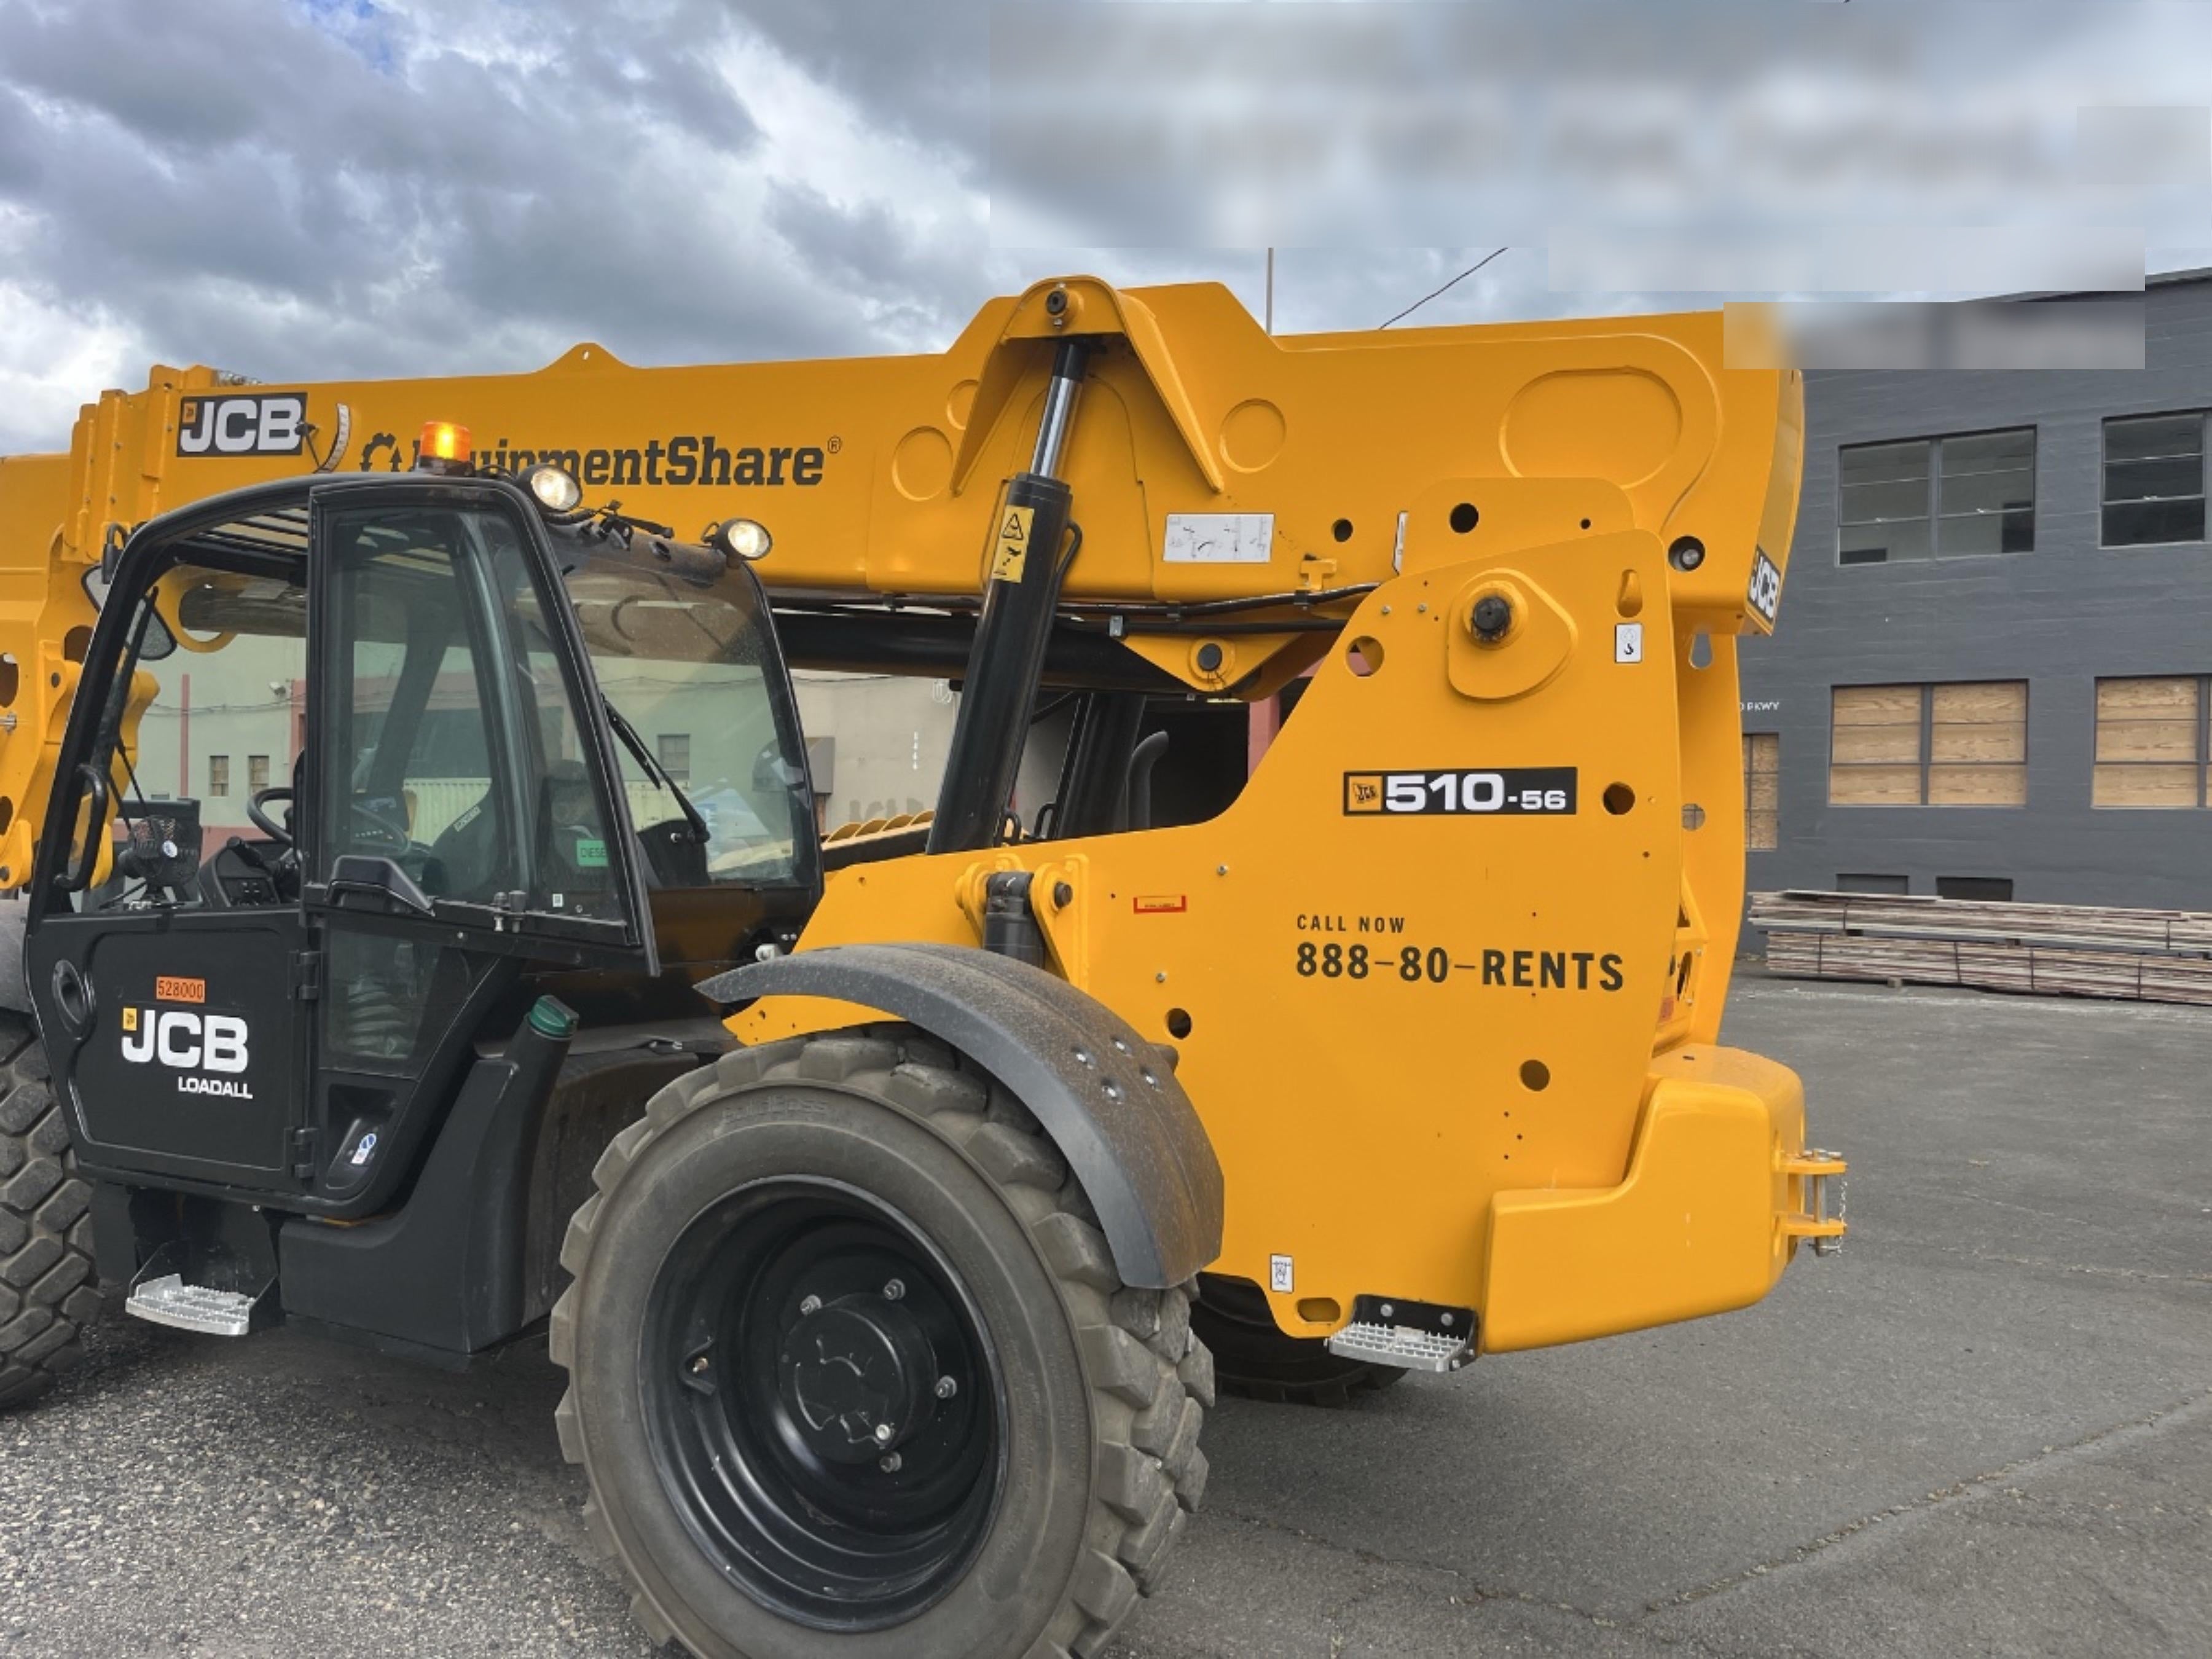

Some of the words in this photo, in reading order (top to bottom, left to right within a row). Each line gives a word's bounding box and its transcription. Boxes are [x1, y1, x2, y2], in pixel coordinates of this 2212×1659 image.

[180, 399, 300, 452] JCB
[1750, 552, 1780, 618] JCB
[1747, 701, 1779, 712] PKWY
[1385, 773, 1566, 811] 510-56
[1296, 914, 1347, 931] CALL
[1359, 917, 1405, 933] NOW
[1296, 942, 1624, 991] 888-80-RENTS
[159, 980, 203, 1000] 528000
[122, 1010, 248, 1073] JCB
[178, 1077, 253, 1099] LOADALL
